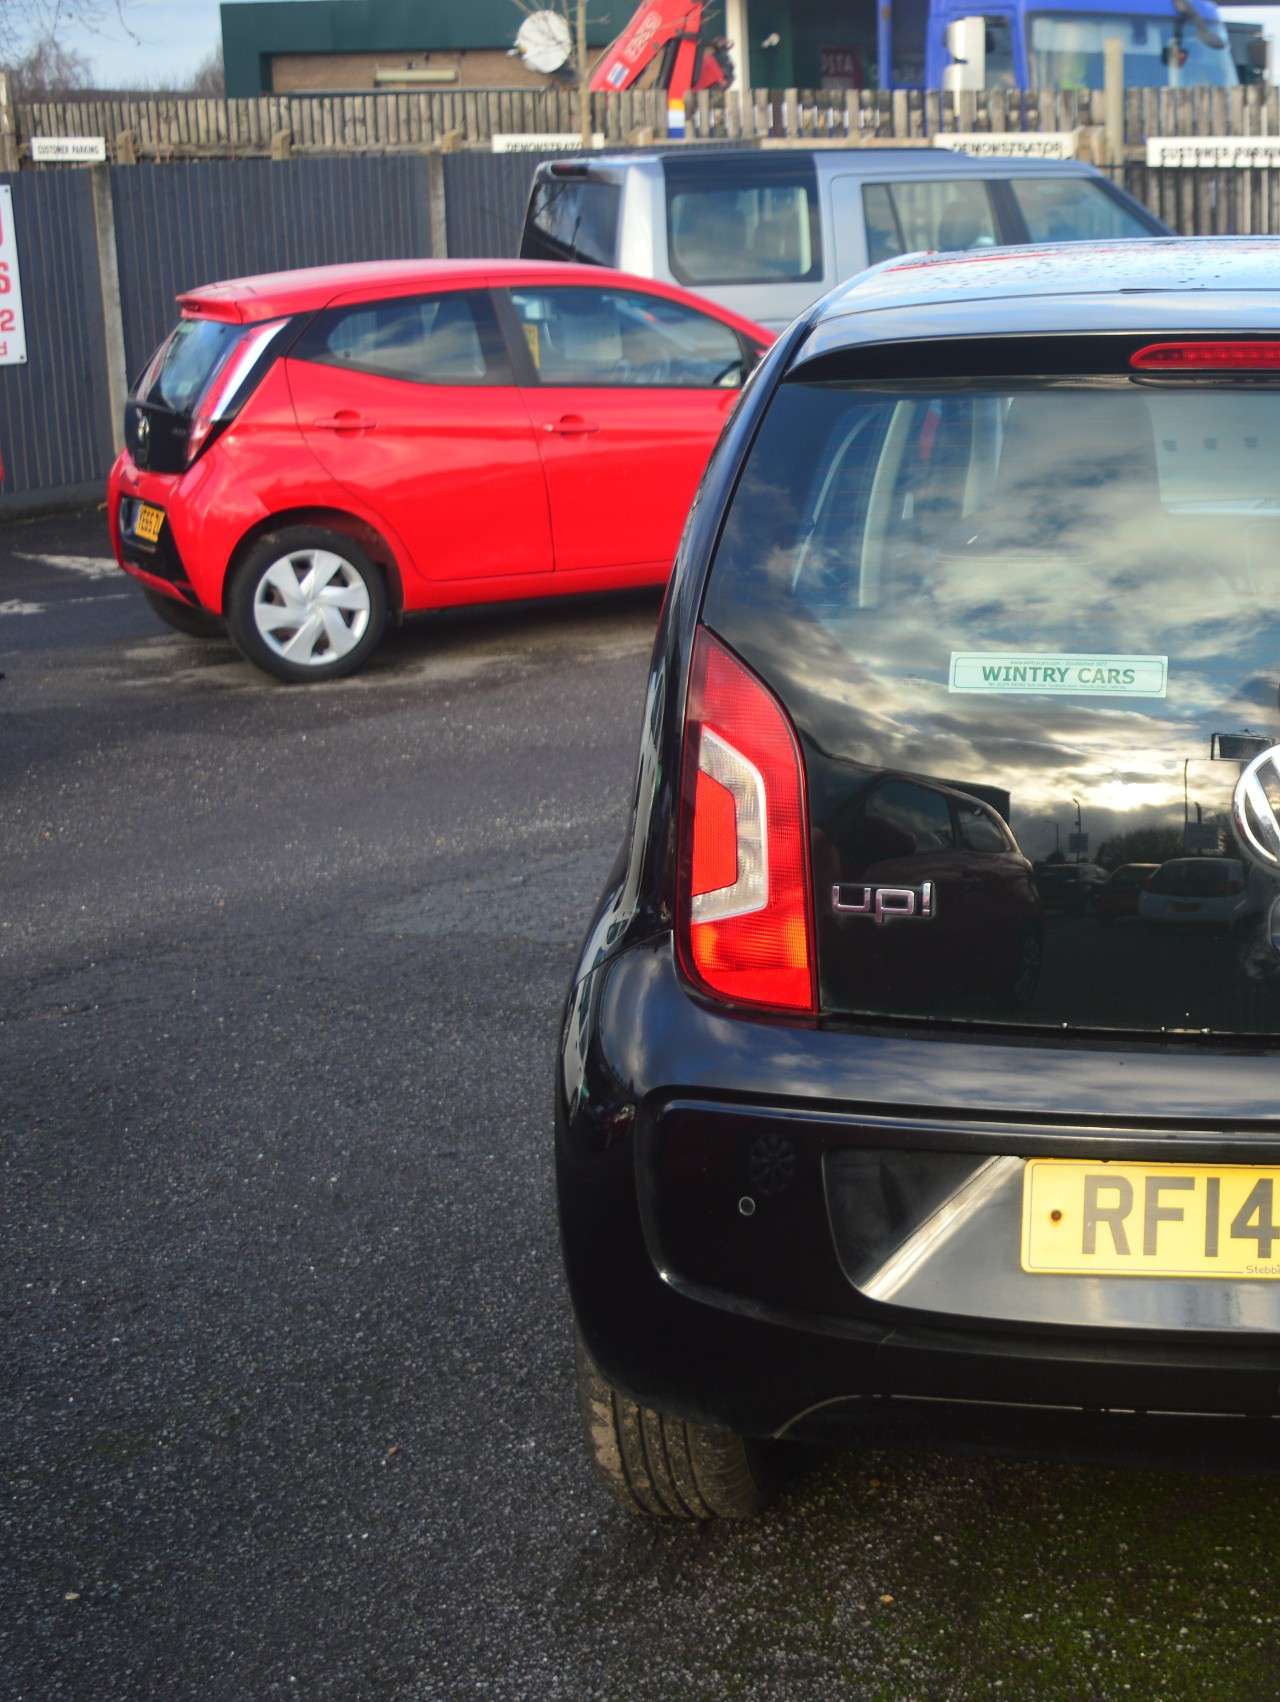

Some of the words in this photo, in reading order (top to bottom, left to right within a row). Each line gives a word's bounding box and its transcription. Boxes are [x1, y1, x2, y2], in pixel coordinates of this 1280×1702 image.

[38, 144, 69, 154] CUSTOMER
[72, 144, 99, 154] PARKING
[506, 143, 582, 152] DEMONSTRATO
[1160, 146, 1229, 159] CUSTOMER
[981, 665, 1071, 683] WINTRY
[1077, 667, 1136, 685] CARS
[1081, 1174, 1280, 1259] RF14
